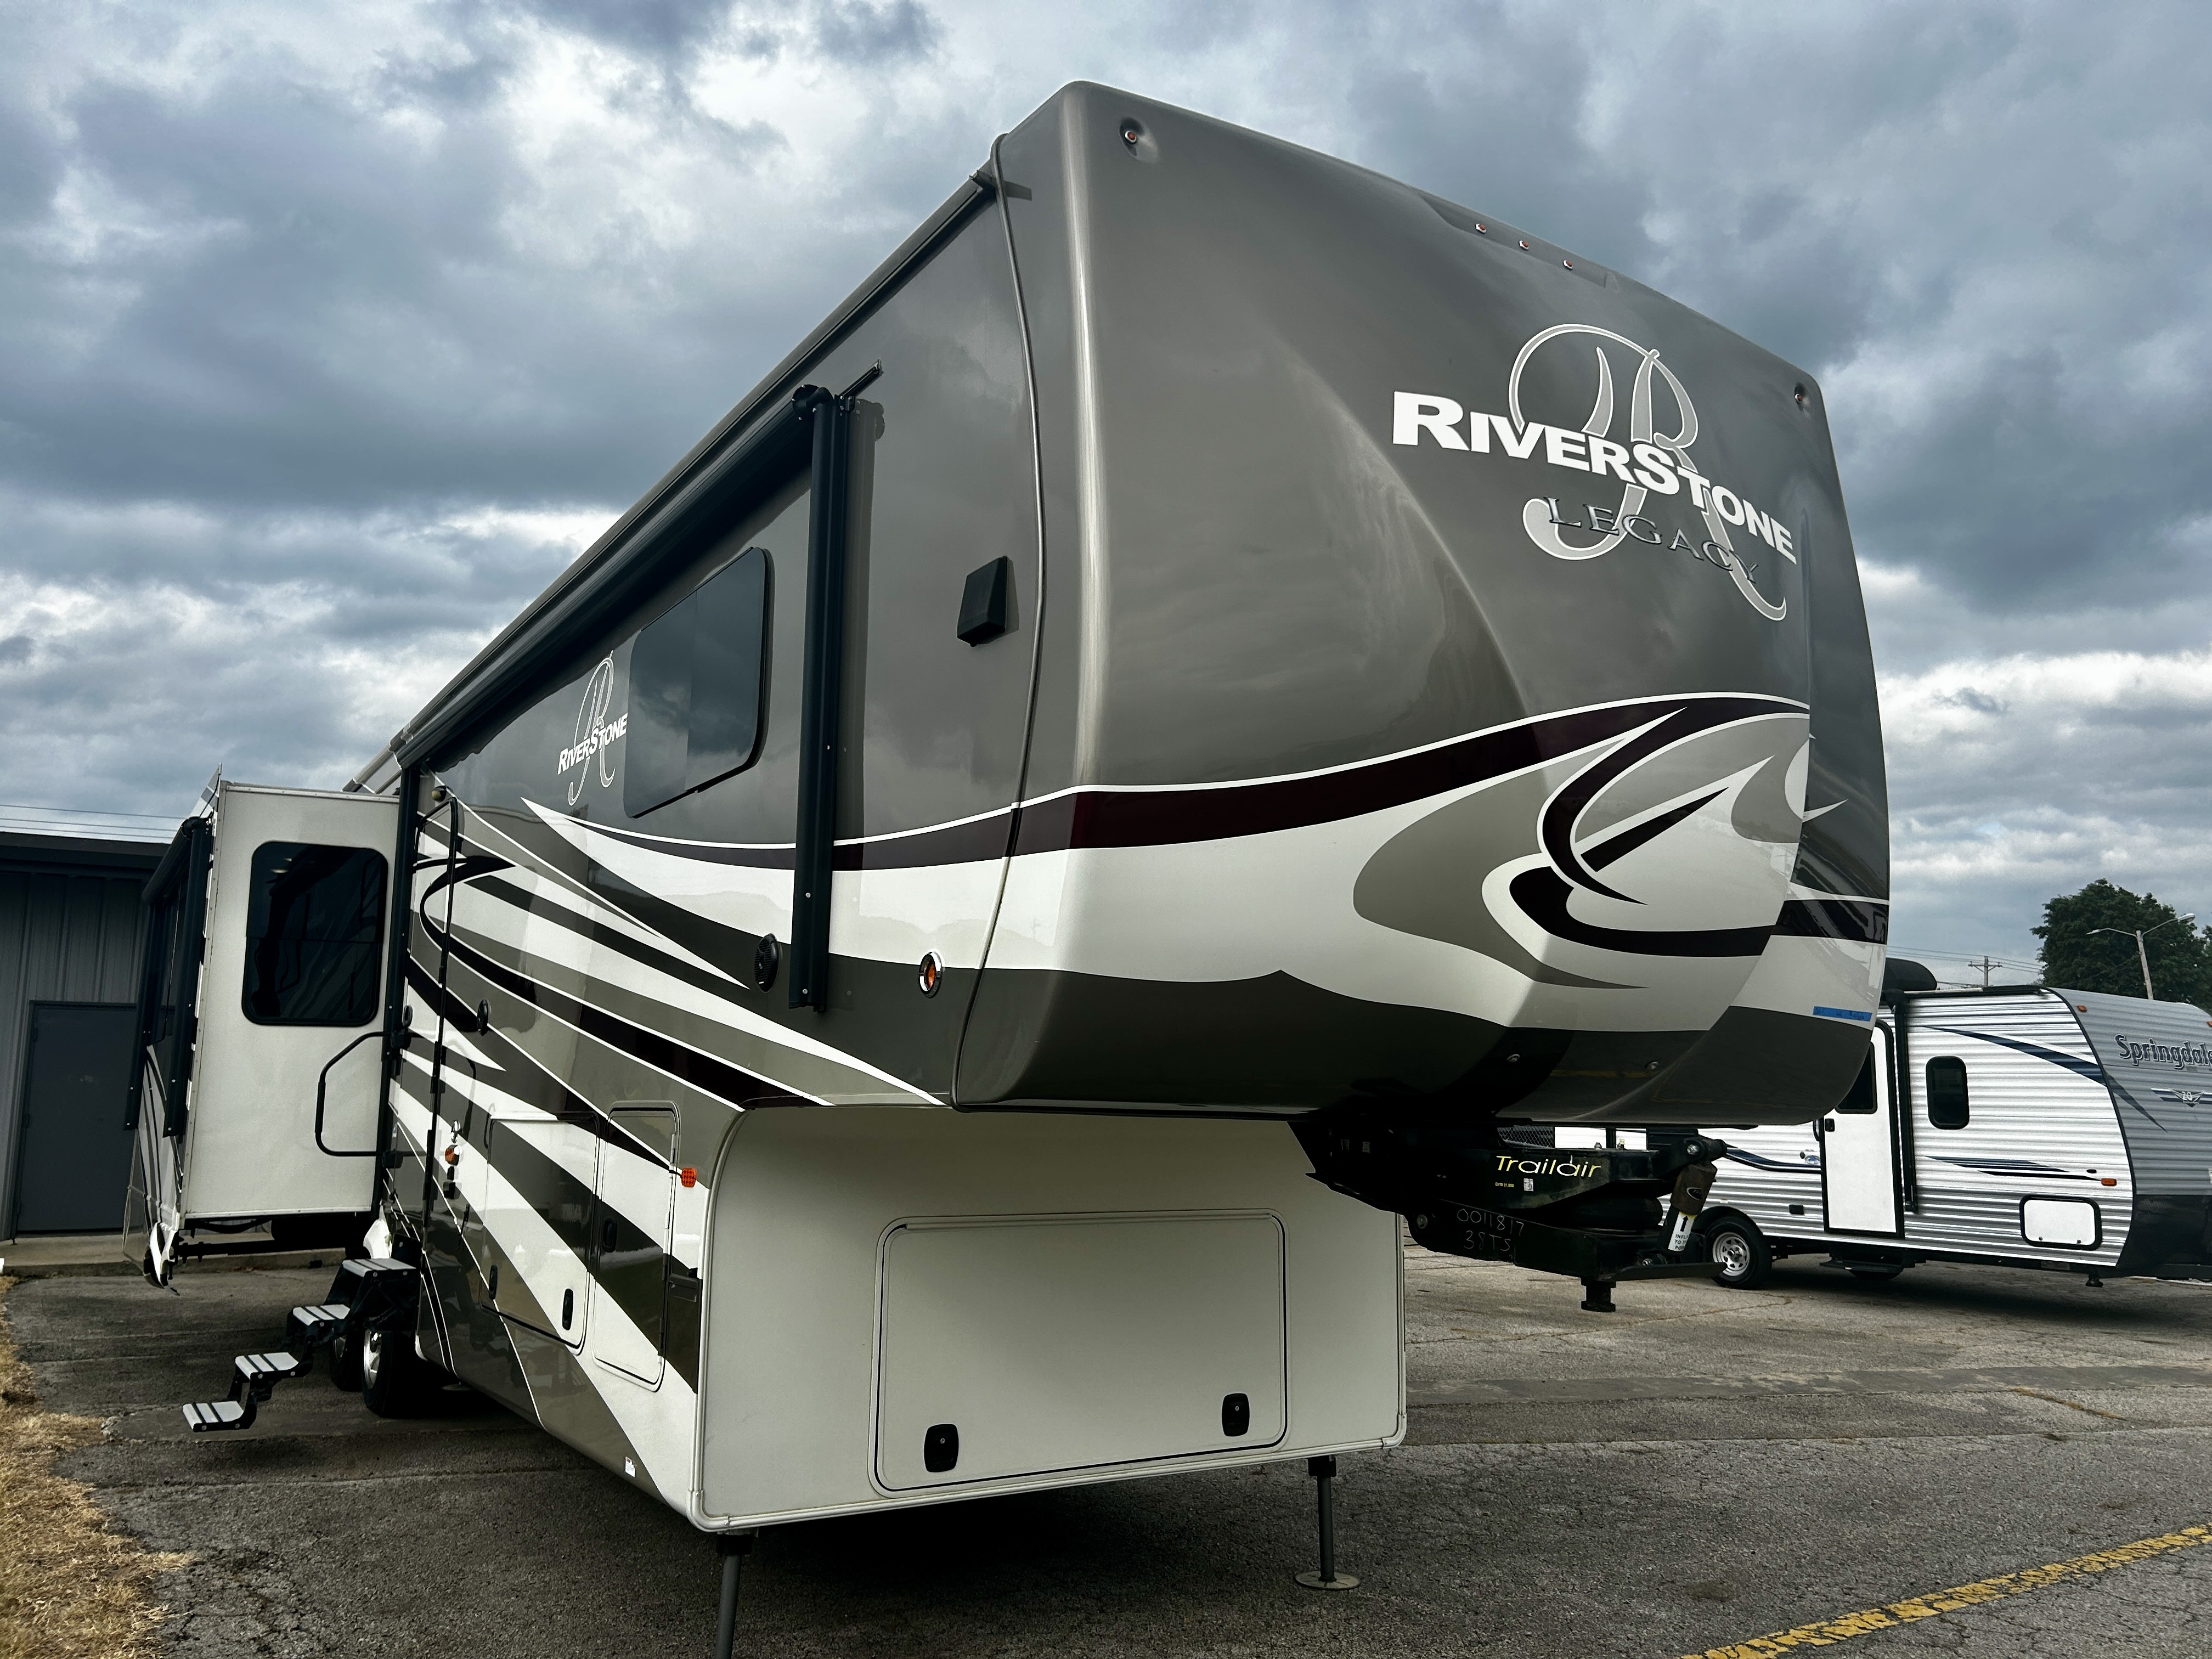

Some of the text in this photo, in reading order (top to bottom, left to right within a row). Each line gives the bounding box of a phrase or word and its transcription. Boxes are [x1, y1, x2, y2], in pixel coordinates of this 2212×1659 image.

[1542, 496, 1759, 583] LEGACY
[2115, 1034, 2212, 1069] Springdale
[1496, 1155, 1601, 1177] Trailair
[1457, 1209, 1524, 1236] 0011817
